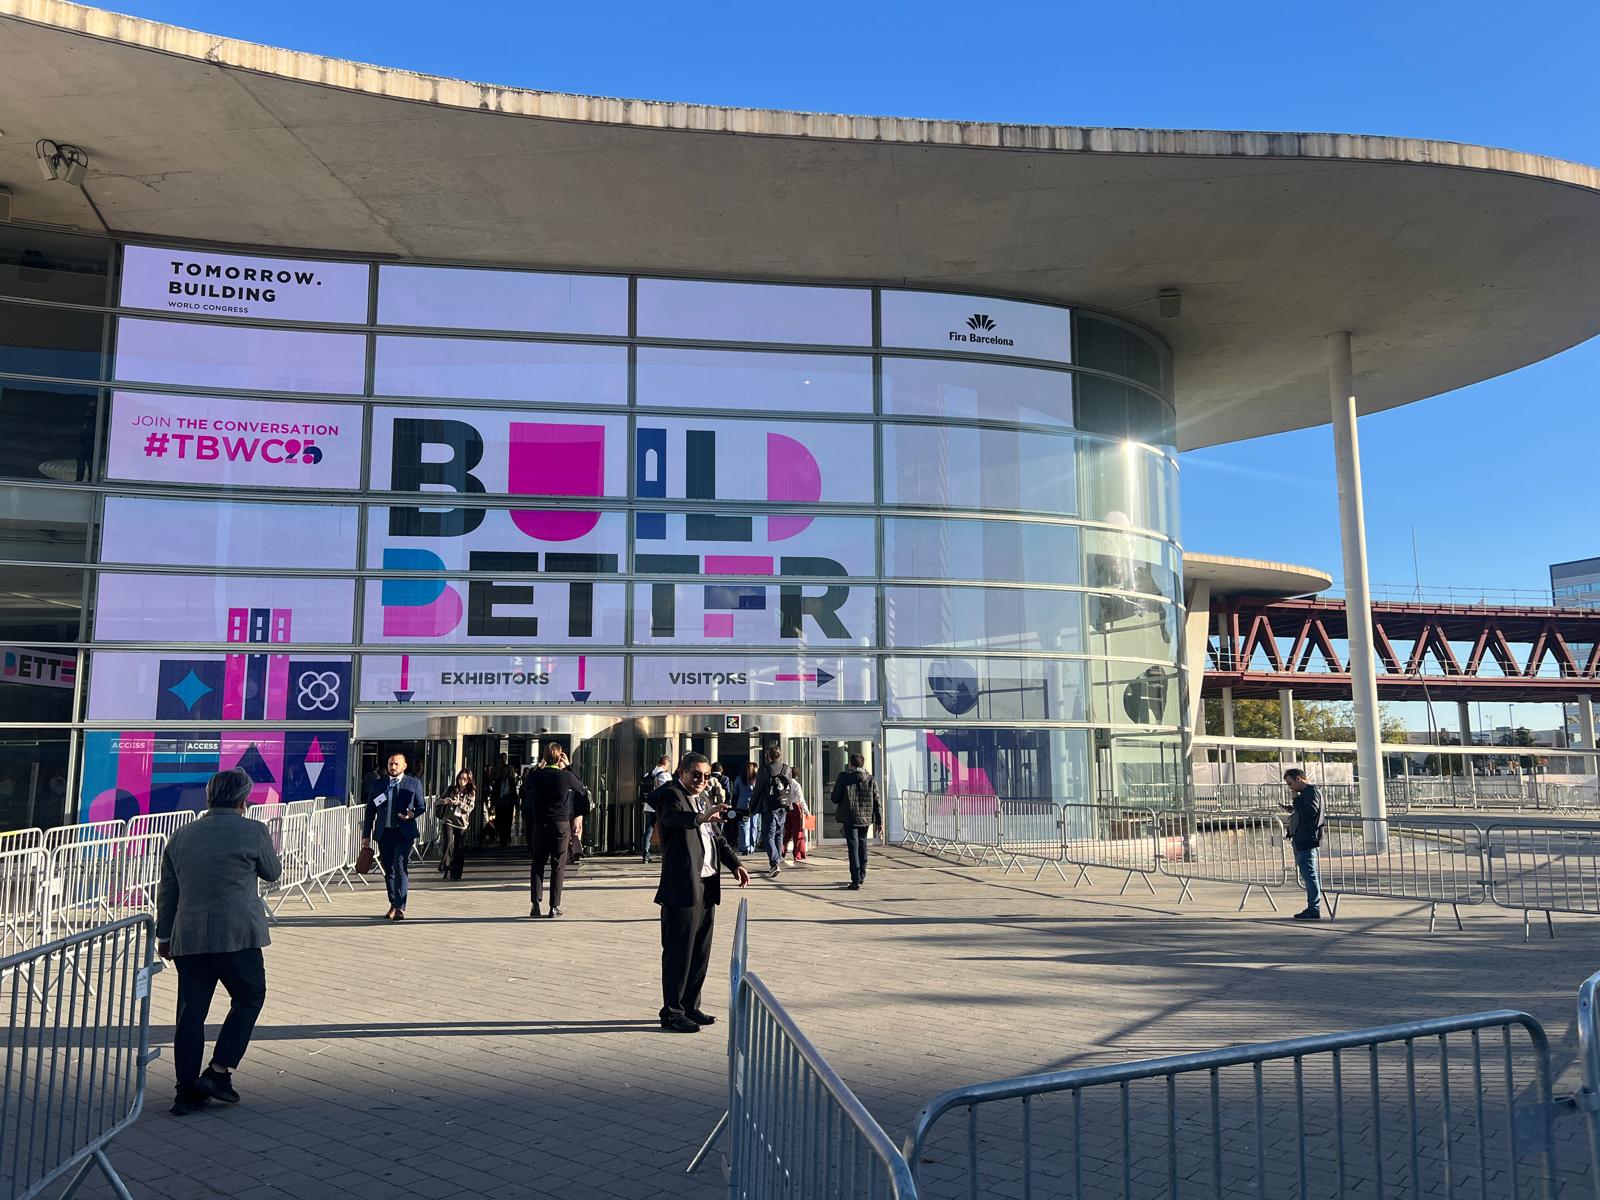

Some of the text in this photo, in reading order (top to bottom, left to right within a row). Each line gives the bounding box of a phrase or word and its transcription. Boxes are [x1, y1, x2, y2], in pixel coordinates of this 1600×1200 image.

[171, 261, 322, 286] TOMORROW.
[168, 281, 276, 303] BUILDING
[168, 301, 249, 314] WORLD CONGRESS
[949, 331, 1014, 346] Fira Barcelona
[132, 415, 339, 436] JOIN THE CONVERSATION
[143, 432, 323, 465] #TBWC25
[388, 417, 822, 542] BUILD
[381, 548, 853, 639] BETTER
[440, 671, 550, 686] EXHIBITORS
[668, 671, 748, 686] VISITORS
[111, 741, 146, 750] ACCESS
[186, 742, 219, 750] ACCESS
